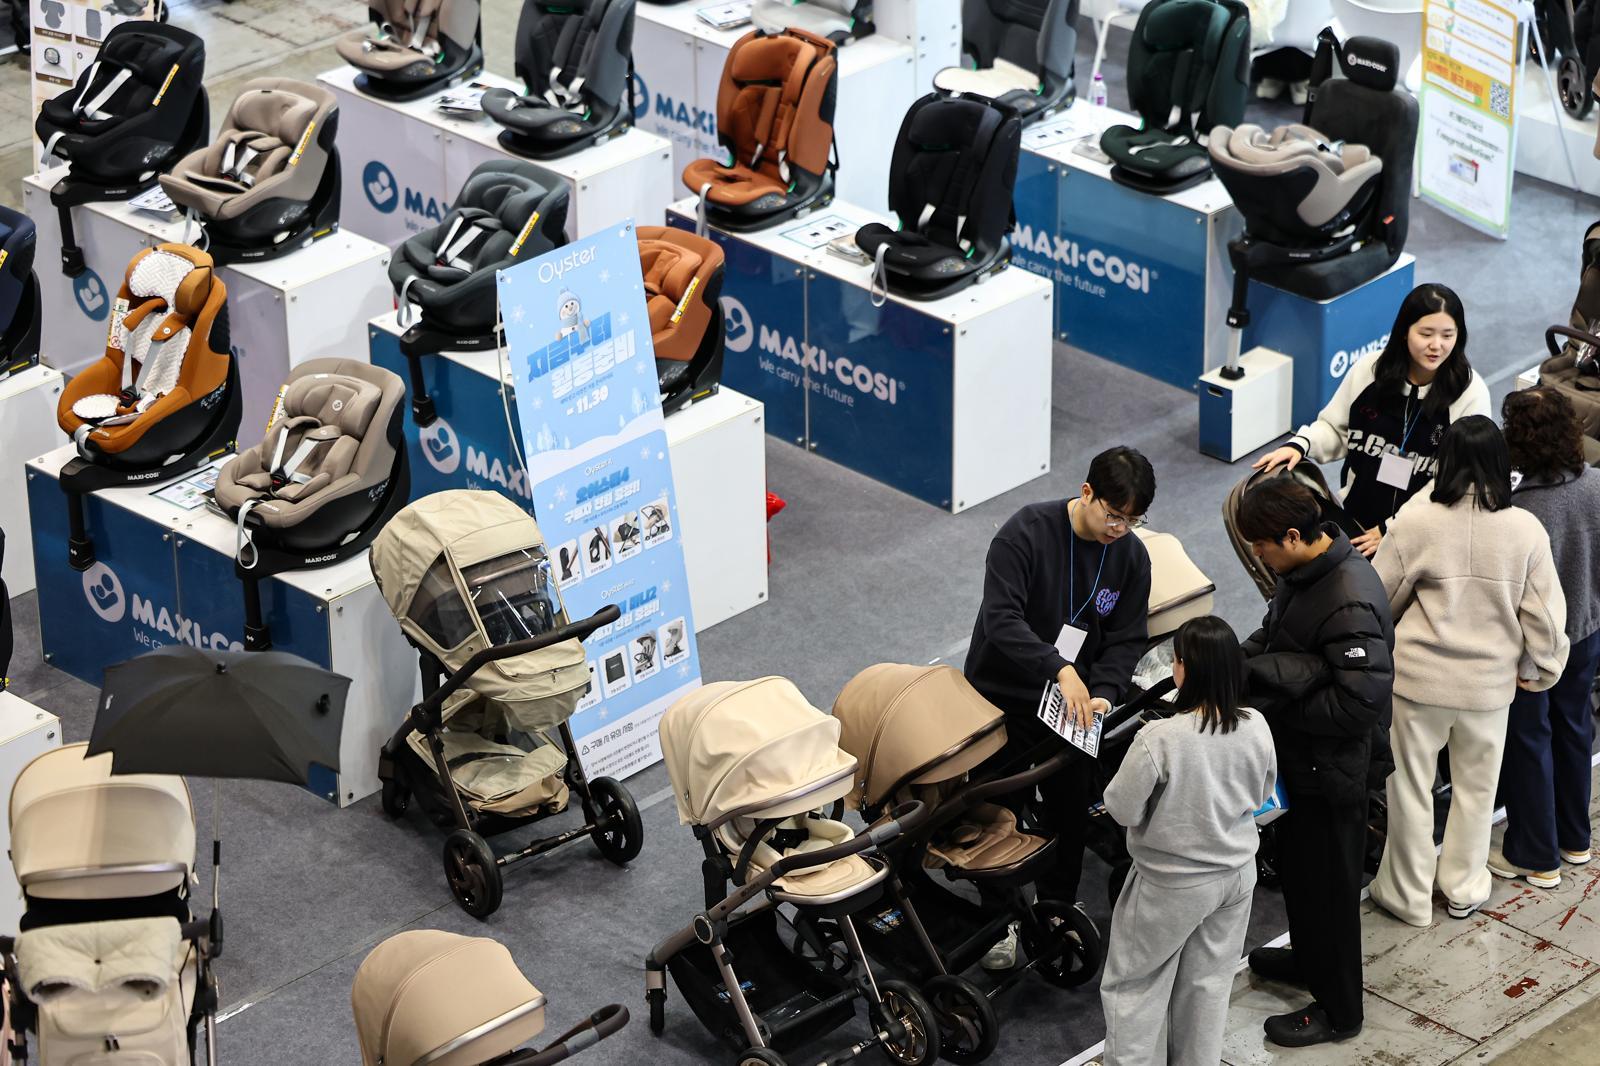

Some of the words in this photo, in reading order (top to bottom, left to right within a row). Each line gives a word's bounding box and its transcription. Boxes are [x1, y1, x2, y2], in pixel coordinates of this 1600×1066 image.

[538, 245, 597, 284] Oyster
[1054, 269, 1073, 285] the
[1074, 275, 1106, 298] future
[758, 355, 775, 374] We
[776, 366, 800, 387] carry
[802, 376, 820, 393] the
[823, 383, 855, 407] future
[133, 627, 150, 647] We
